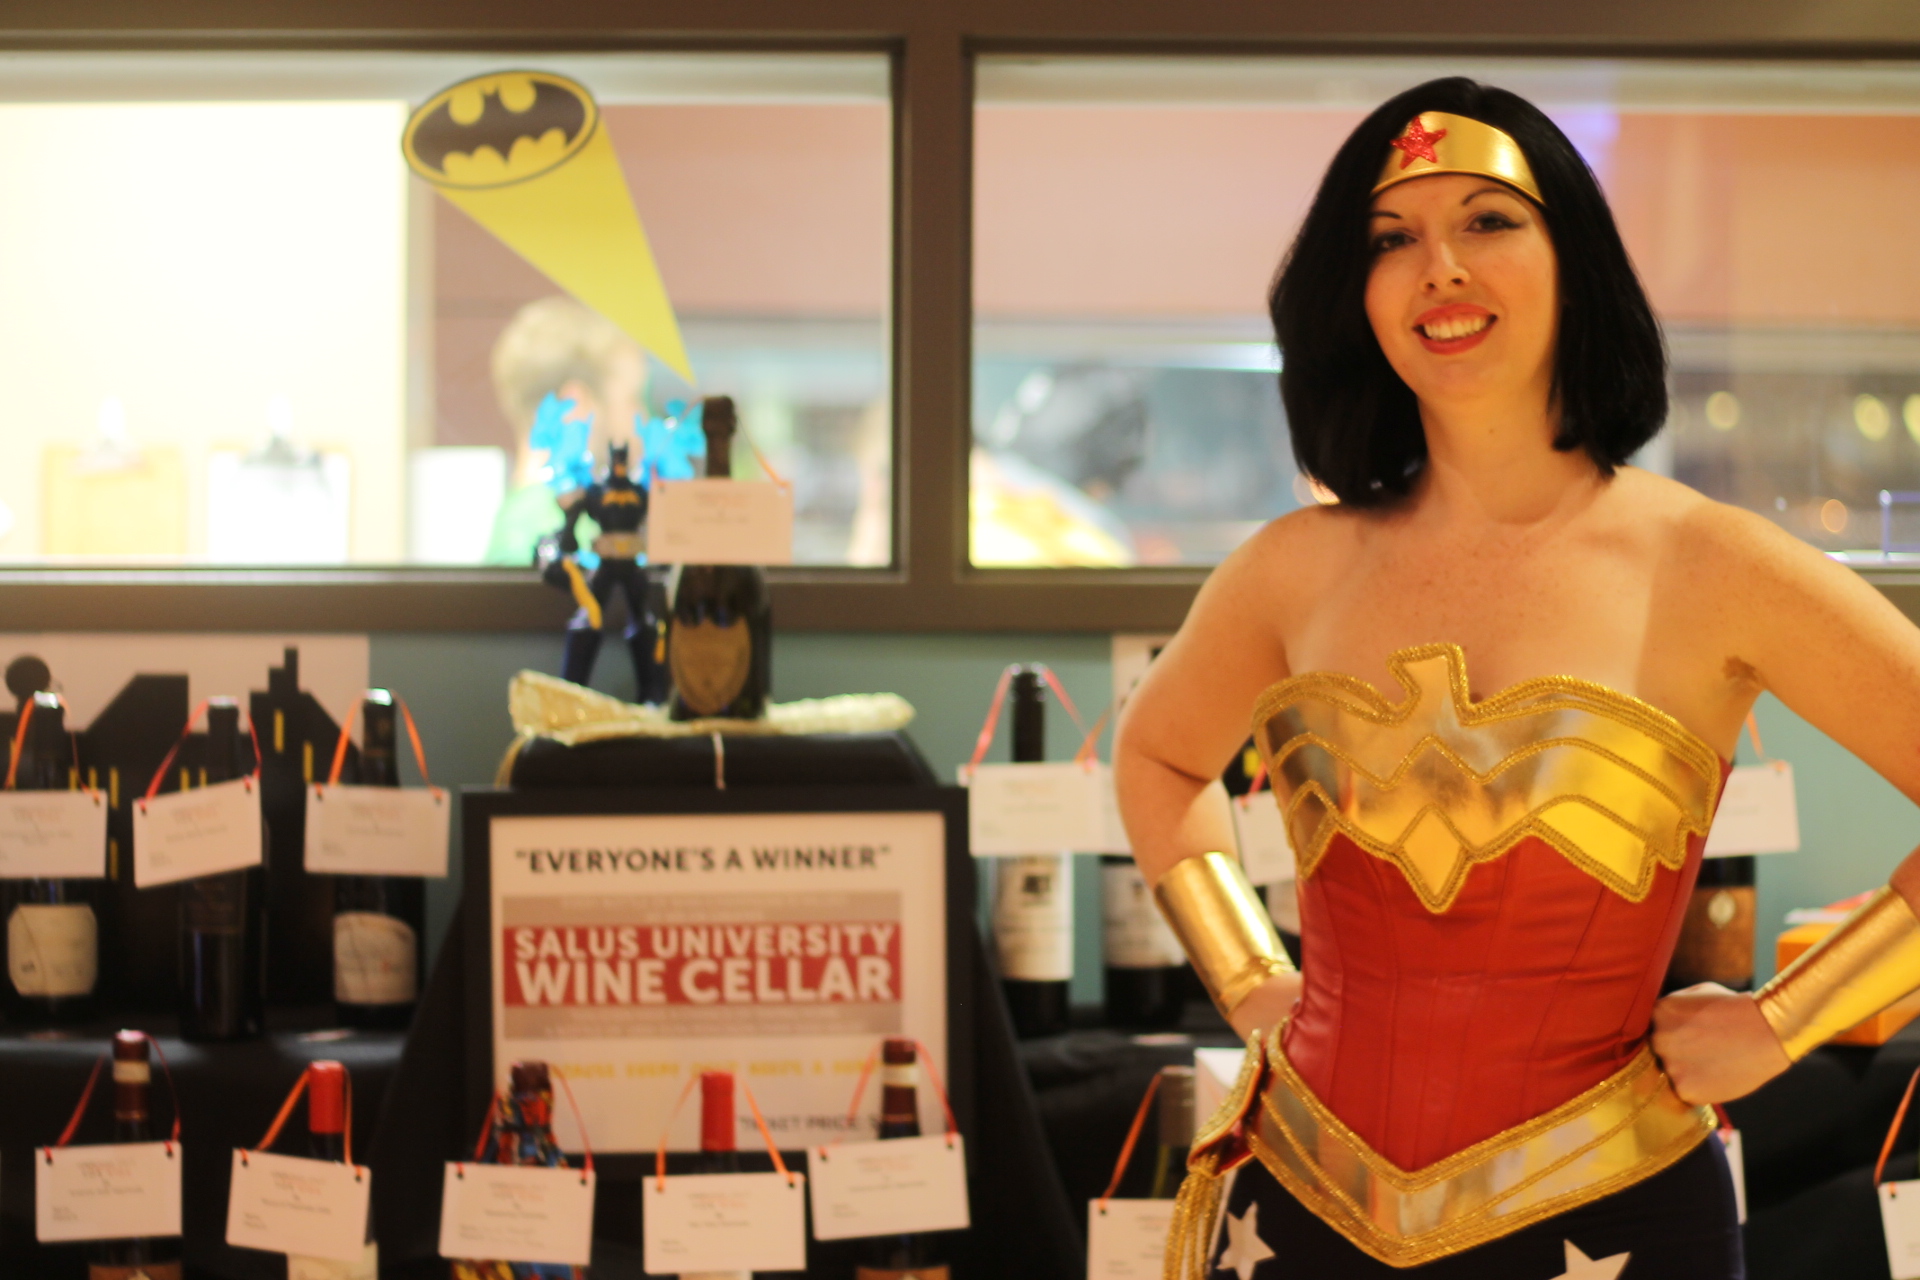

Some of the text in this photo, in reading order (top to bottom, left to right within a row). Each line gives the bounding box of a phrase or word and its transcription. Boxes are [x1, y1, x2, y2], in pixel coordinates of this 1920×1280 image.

[516, 844, 891, 874] "EVERYONE'S A WINNER"
[515, 923, 893, 960] SALUS UNIVERSITY
[515, 956, 894, 1005] WINE CELLAR
